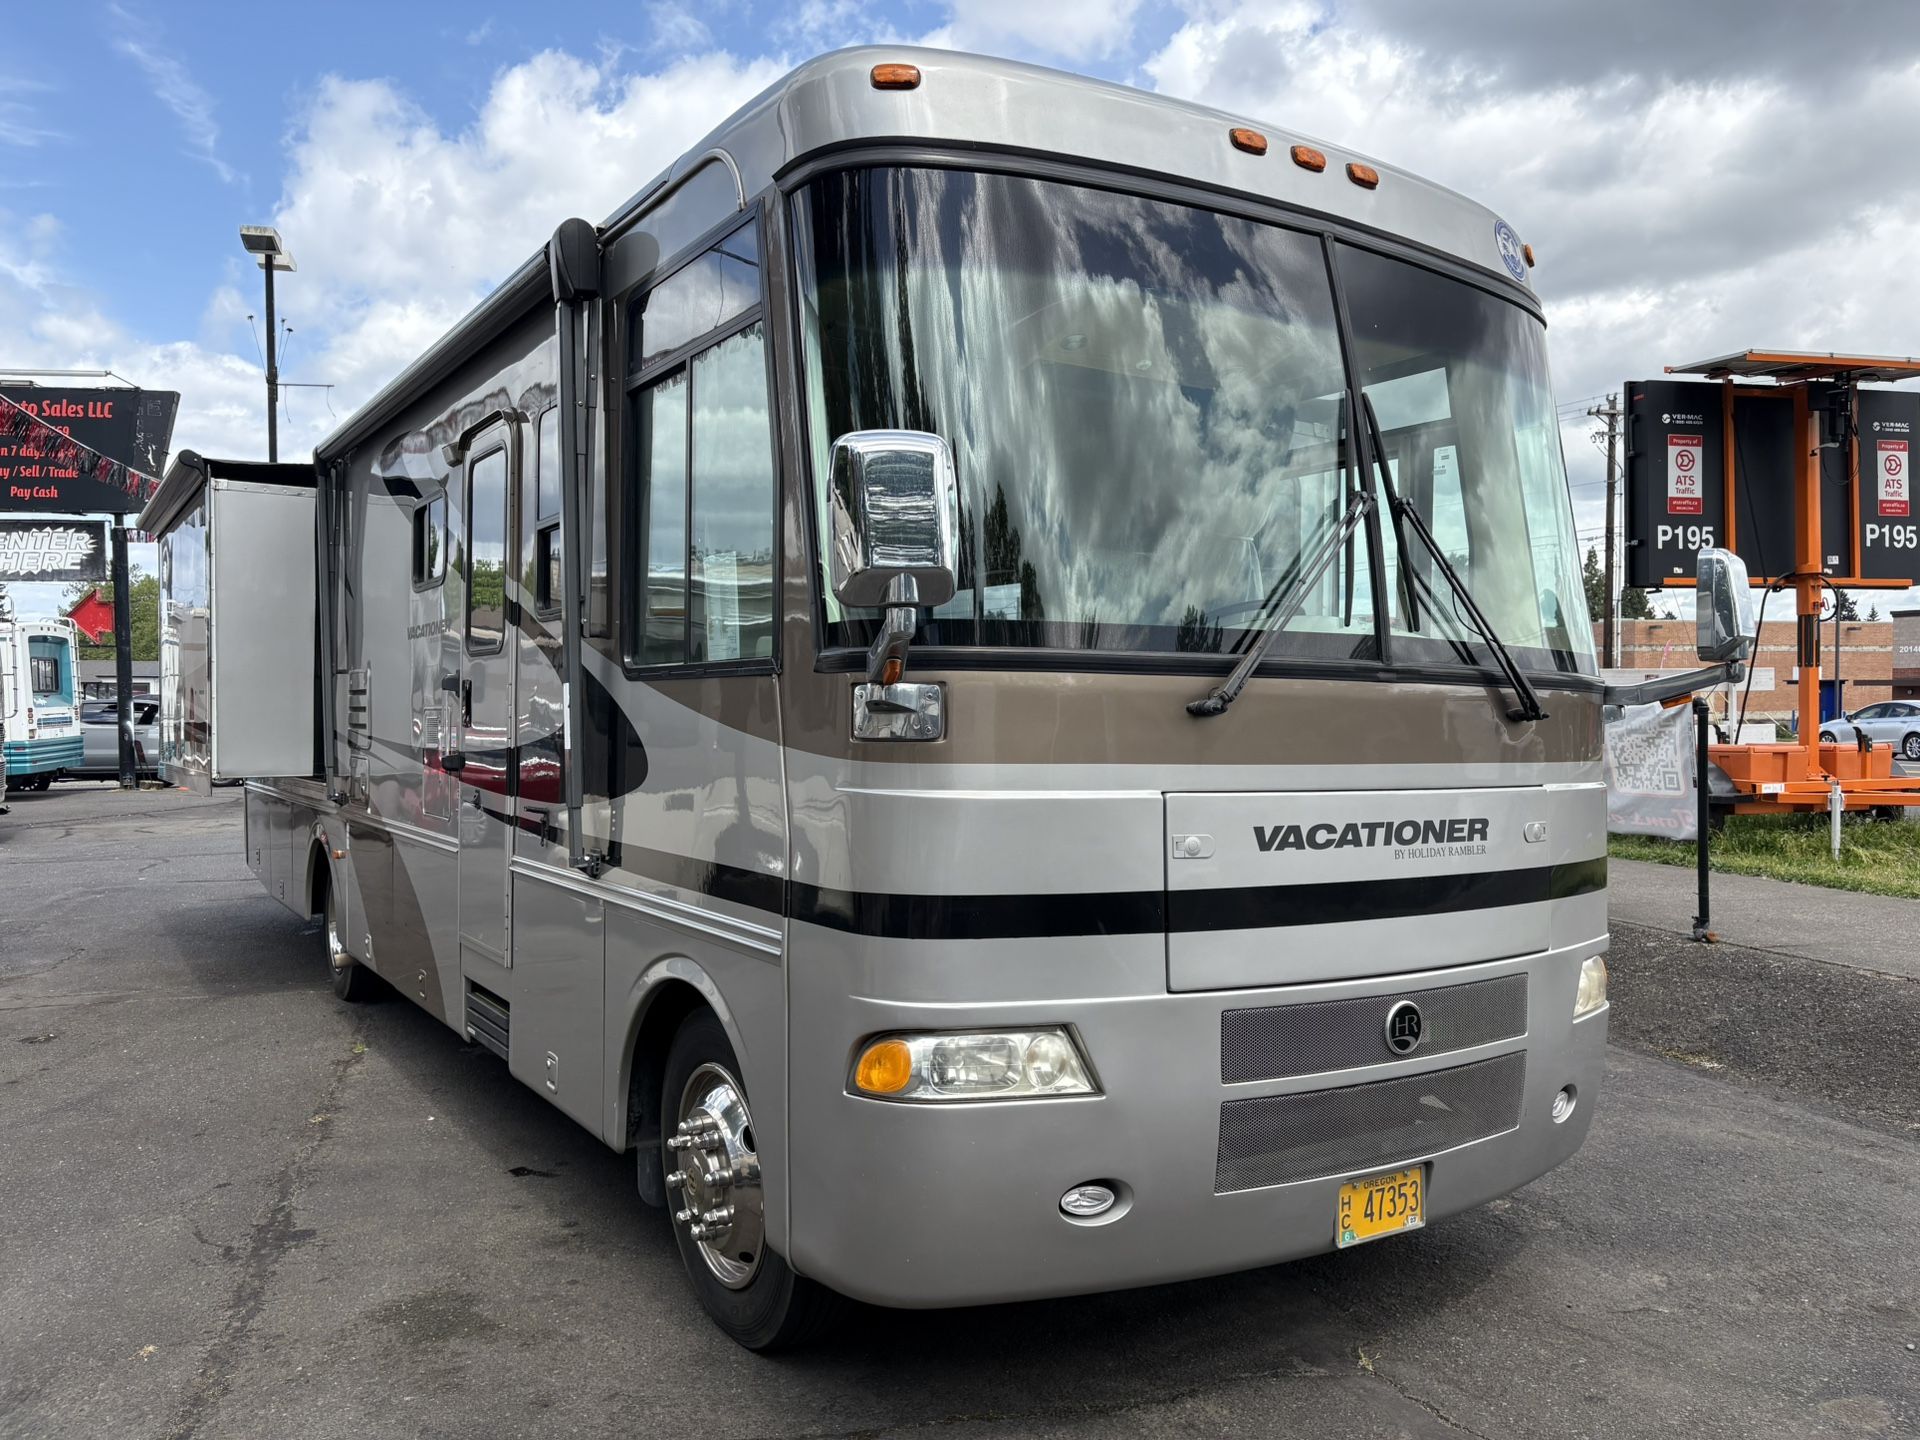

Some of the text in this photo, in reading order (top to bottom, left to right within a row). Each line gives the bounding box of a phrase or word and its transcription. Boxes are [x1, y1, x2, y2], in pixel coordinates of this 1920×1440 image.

[42, 398, 84, 418] Sales
[88, 401, 113, 418] LLC
[1672, 413, 1704, 421] VER-MAC
[11, 444, 18, 457] 7
[20, 465, 40, 477] Sell
[48, 466, 79, 478] Trade
[1675, 475, 1695, 486] ATS
[1885, 479, 1903, 489] ATS
[10, 486, 58, 500] Pay Cash
[1675, 487, 1696, 495] Traffic
[1884, 490, 1903, 498] Traffic
[1657, 525, 1715, 550] P195
[1865, 523, 1918, 549] P195
[0, 551, 83, 571] HERE
[1898, 645, 1920, 654] 2014
[1253, 818, 1490, 852] VACATIONER
[1394, 844, 1487, 860] BY HOLIDAY RAMBLER
[1394, 1014, 1418, 1037] HR
[1363, 1175, 1397, 1189] OREGON
[1363, 1180, 1419, 1223] 47353
